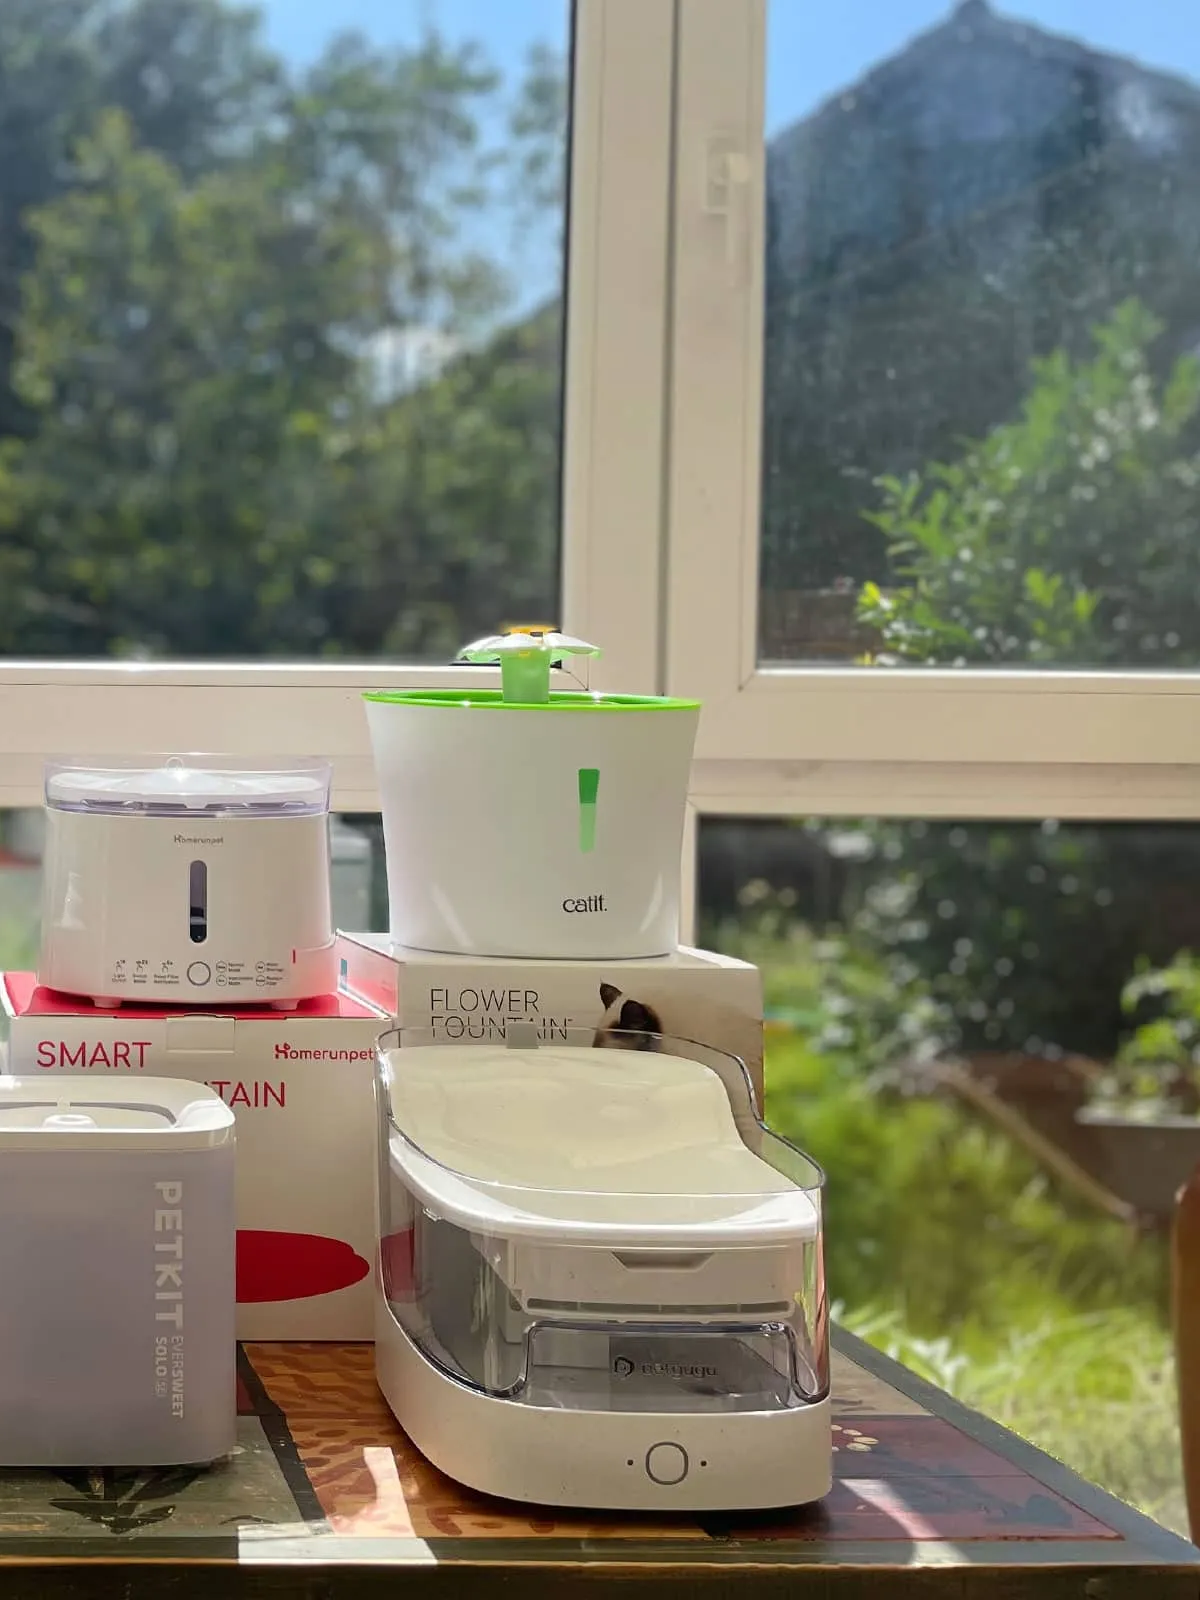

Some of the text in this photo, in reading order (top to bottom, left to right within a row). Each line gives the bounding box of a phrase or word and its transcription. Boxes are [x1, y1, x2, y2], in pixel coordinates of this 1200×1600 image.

[430, 988, 539, 1013] FLOWER
[36, 1040, 153, 1069] SMART
[274, 1042, 375, 1063] Homerunpet
[154, 1180, 184, 1330] PETKIT
[155, 1336, 169, 1377] SOLO
[171, 1335, 184, 1418] EVERSWEET
